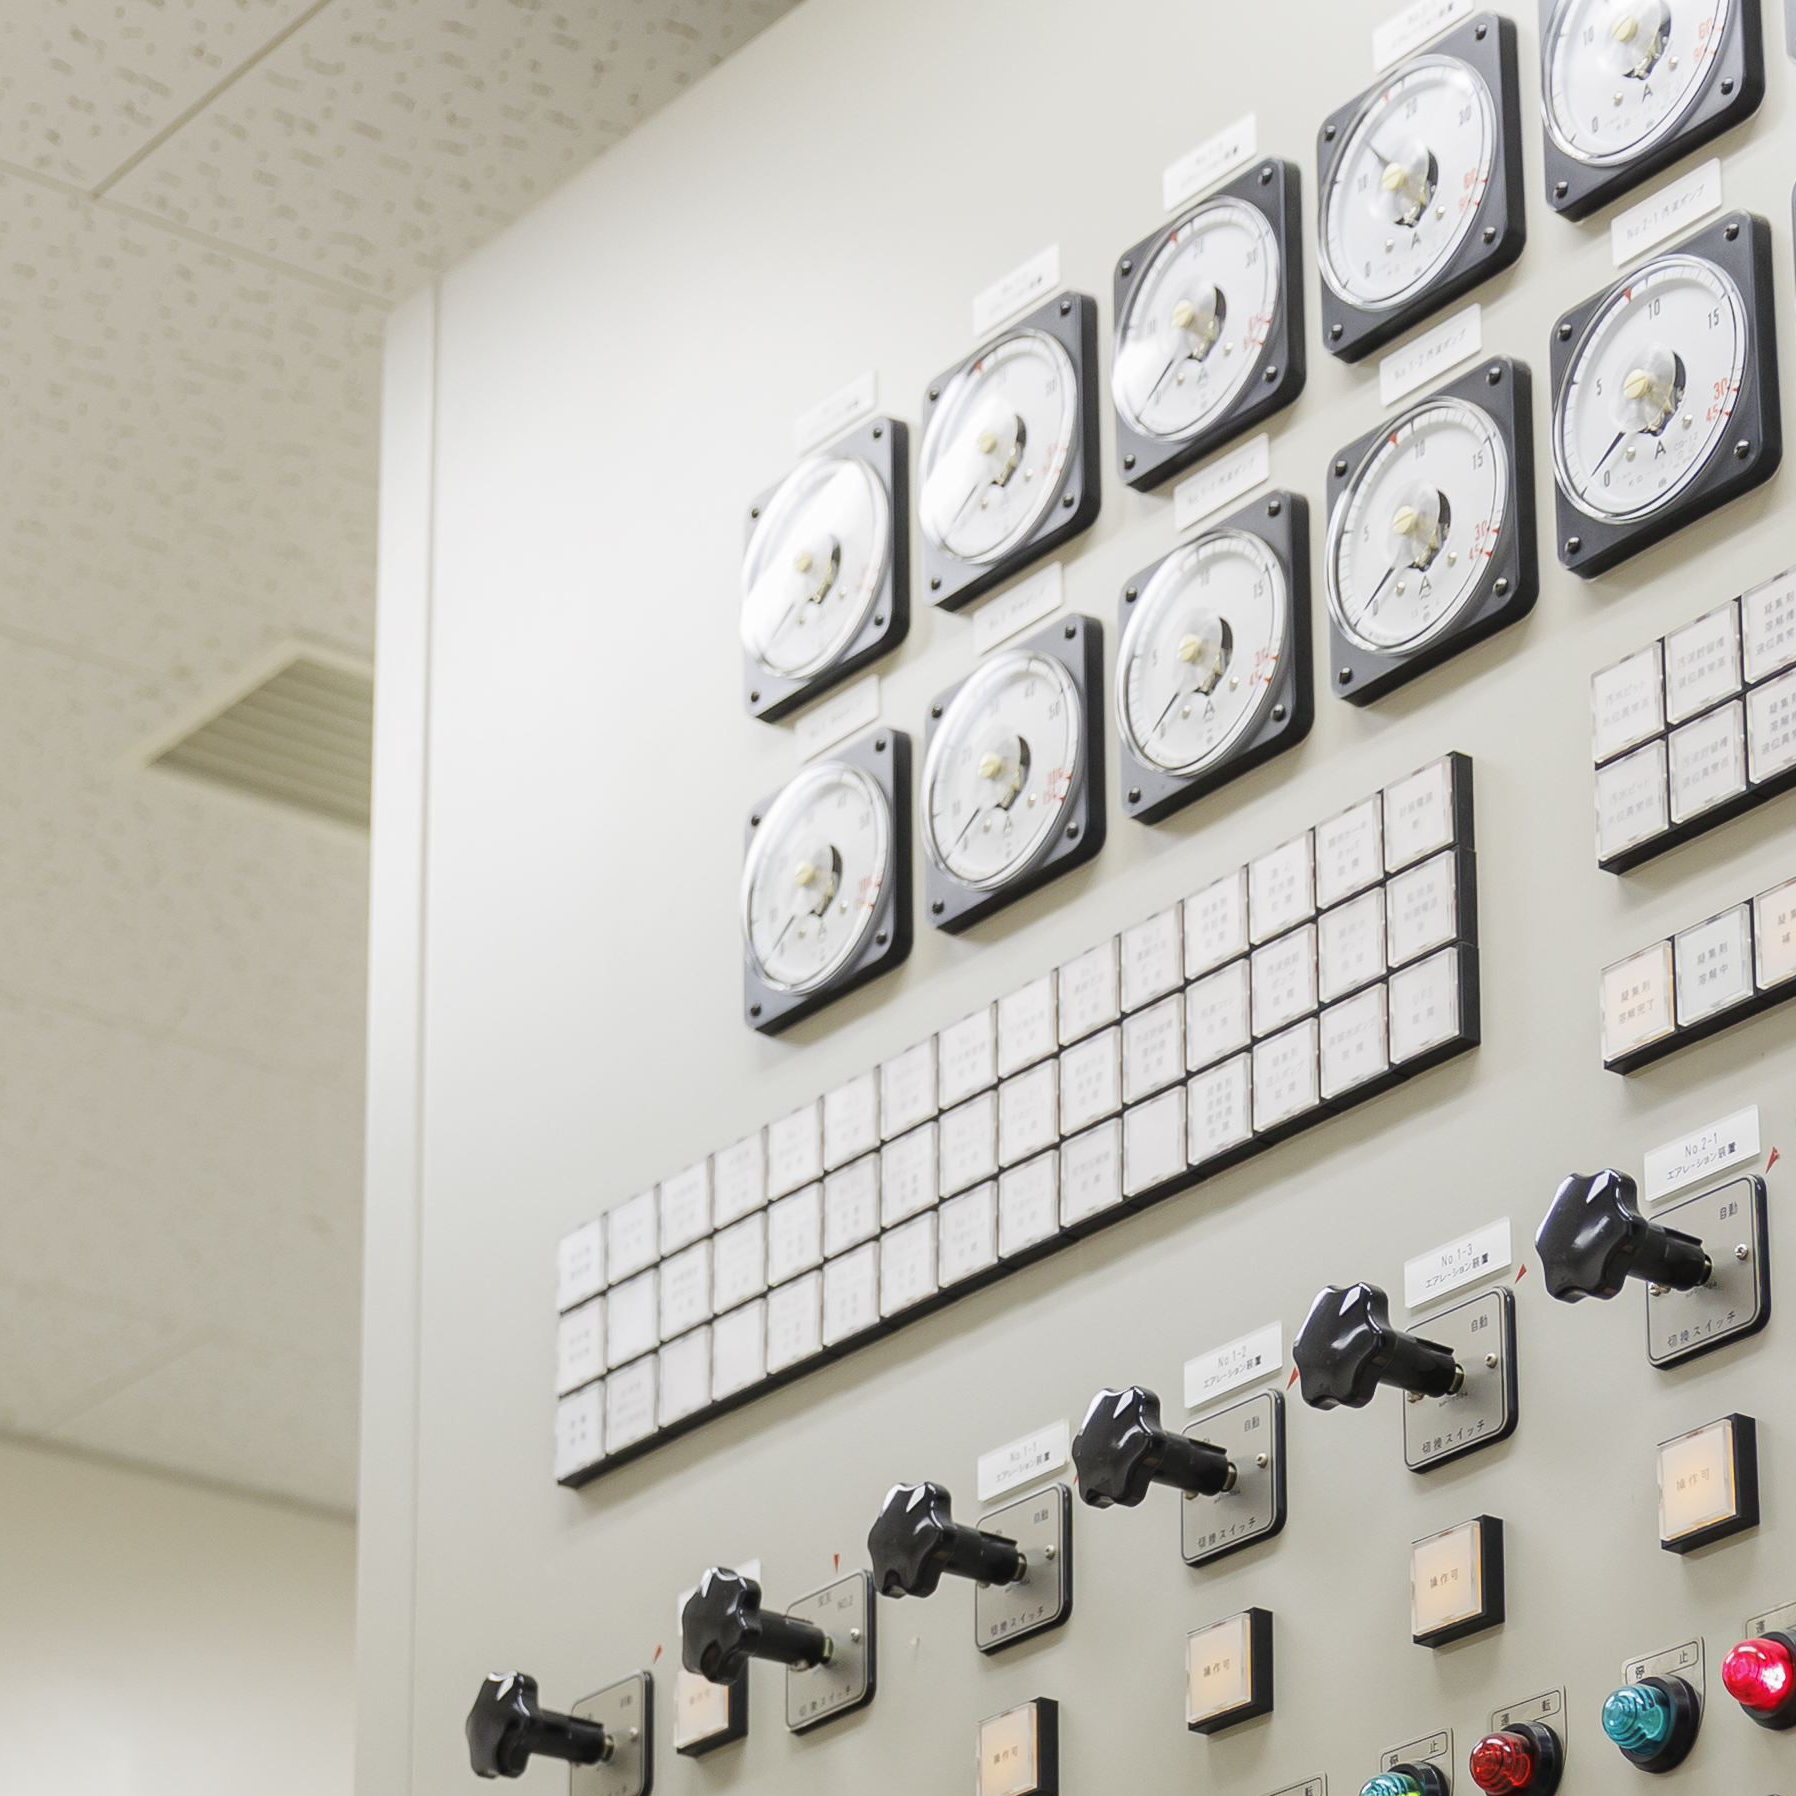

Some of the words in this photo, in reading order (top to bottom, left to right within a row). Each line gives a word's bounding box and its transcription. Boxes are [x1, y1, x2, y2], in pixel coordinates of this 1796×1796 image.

[1648, 301, 1661, 320] 10
[1707, 311, 1719, 329] 15
[1714, 380, 1726, 399] 30
[1683, 1132, 1719, 1158] No.2-1
[1719, 1201, 1739, 1221] 自動
[1440, 1241, 1474, 1268] No.1-3
[1470, 1314, 1489, 1334] 自動
[1667, 1309, 1736, 1349] 切換スイッチ
[1422, 1418, 1486, 1456] 切換スイッチ
